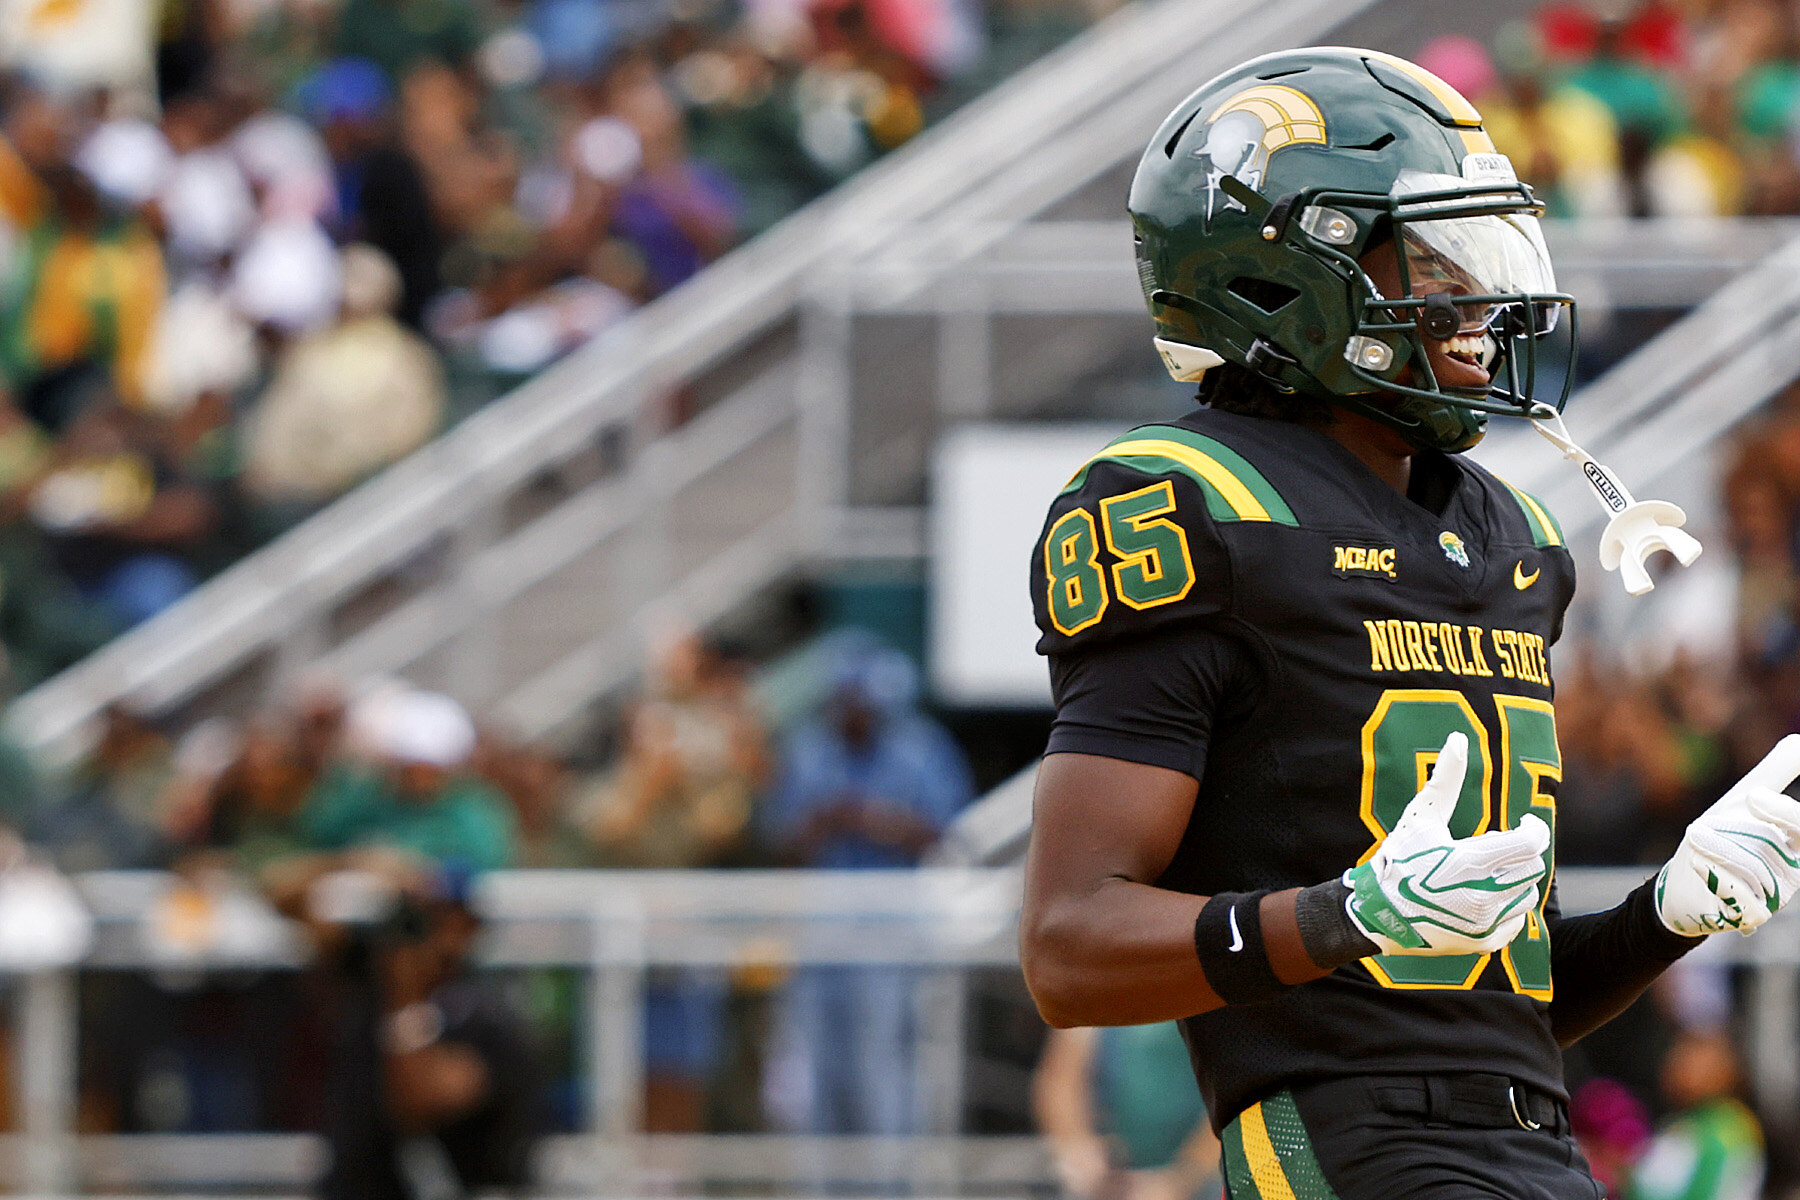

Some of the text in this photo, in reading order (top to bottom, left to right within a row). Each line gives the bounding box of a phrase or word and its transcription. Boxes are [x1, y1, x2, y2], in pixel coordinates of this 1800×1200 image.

[1587, 465, 1623, 508] BATTLE
[1044, 480, 1196, 637] 85
[1334, 546, 1396, 573] MEAC
[1363, 619, 1551, 687] NORFOLK STATE
